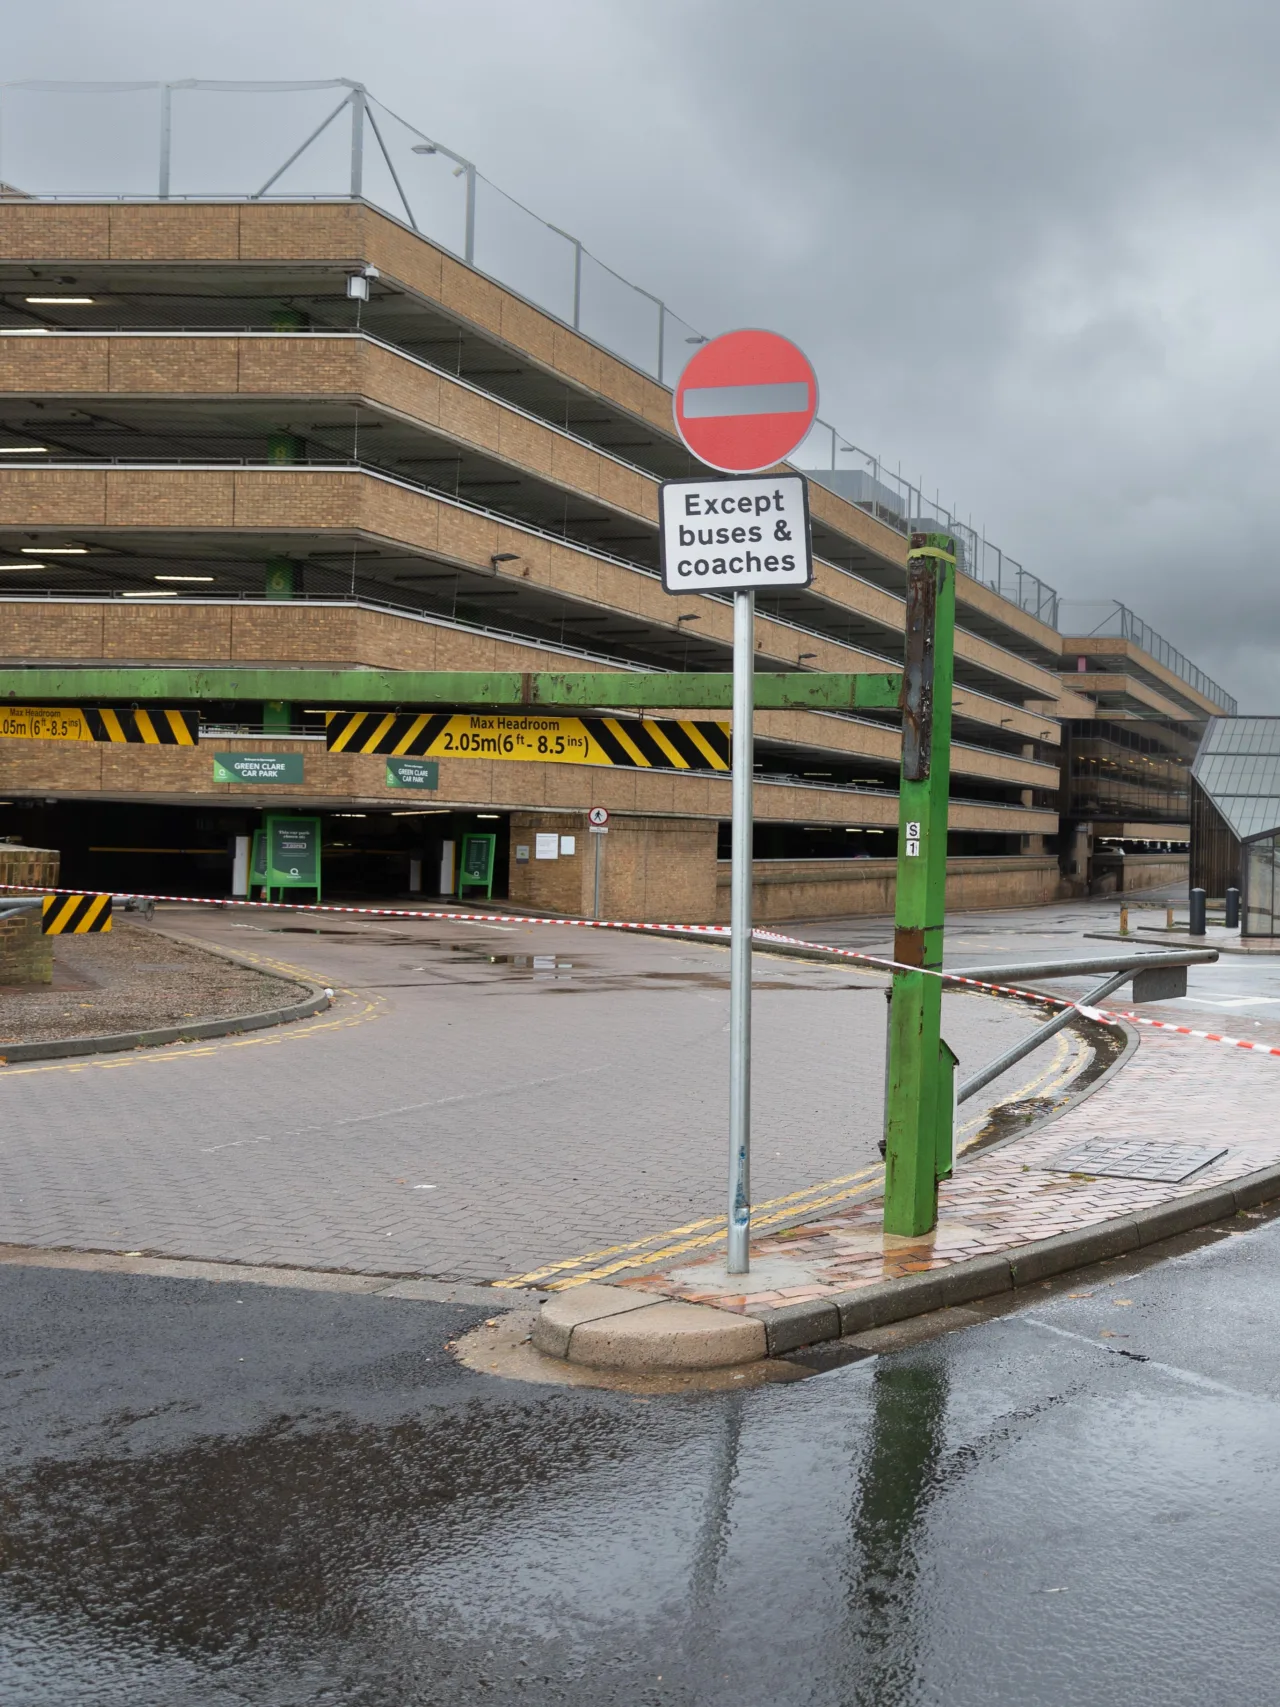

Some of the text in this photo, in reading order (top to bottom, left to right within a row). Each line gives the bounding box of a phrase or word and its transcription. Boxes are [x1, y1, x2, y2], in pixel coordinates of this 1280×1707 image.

[685, 489, 785, 516] Except
[679, 519, 792, 546] buses &
[677, 551, 796, 577] coaches
[10, 708, 61, 718] Max Headroom
[470, 716, 560, 730] Max Headroom
[909, 824, 918, 836] S
[910, 842, 915, 854] 1
